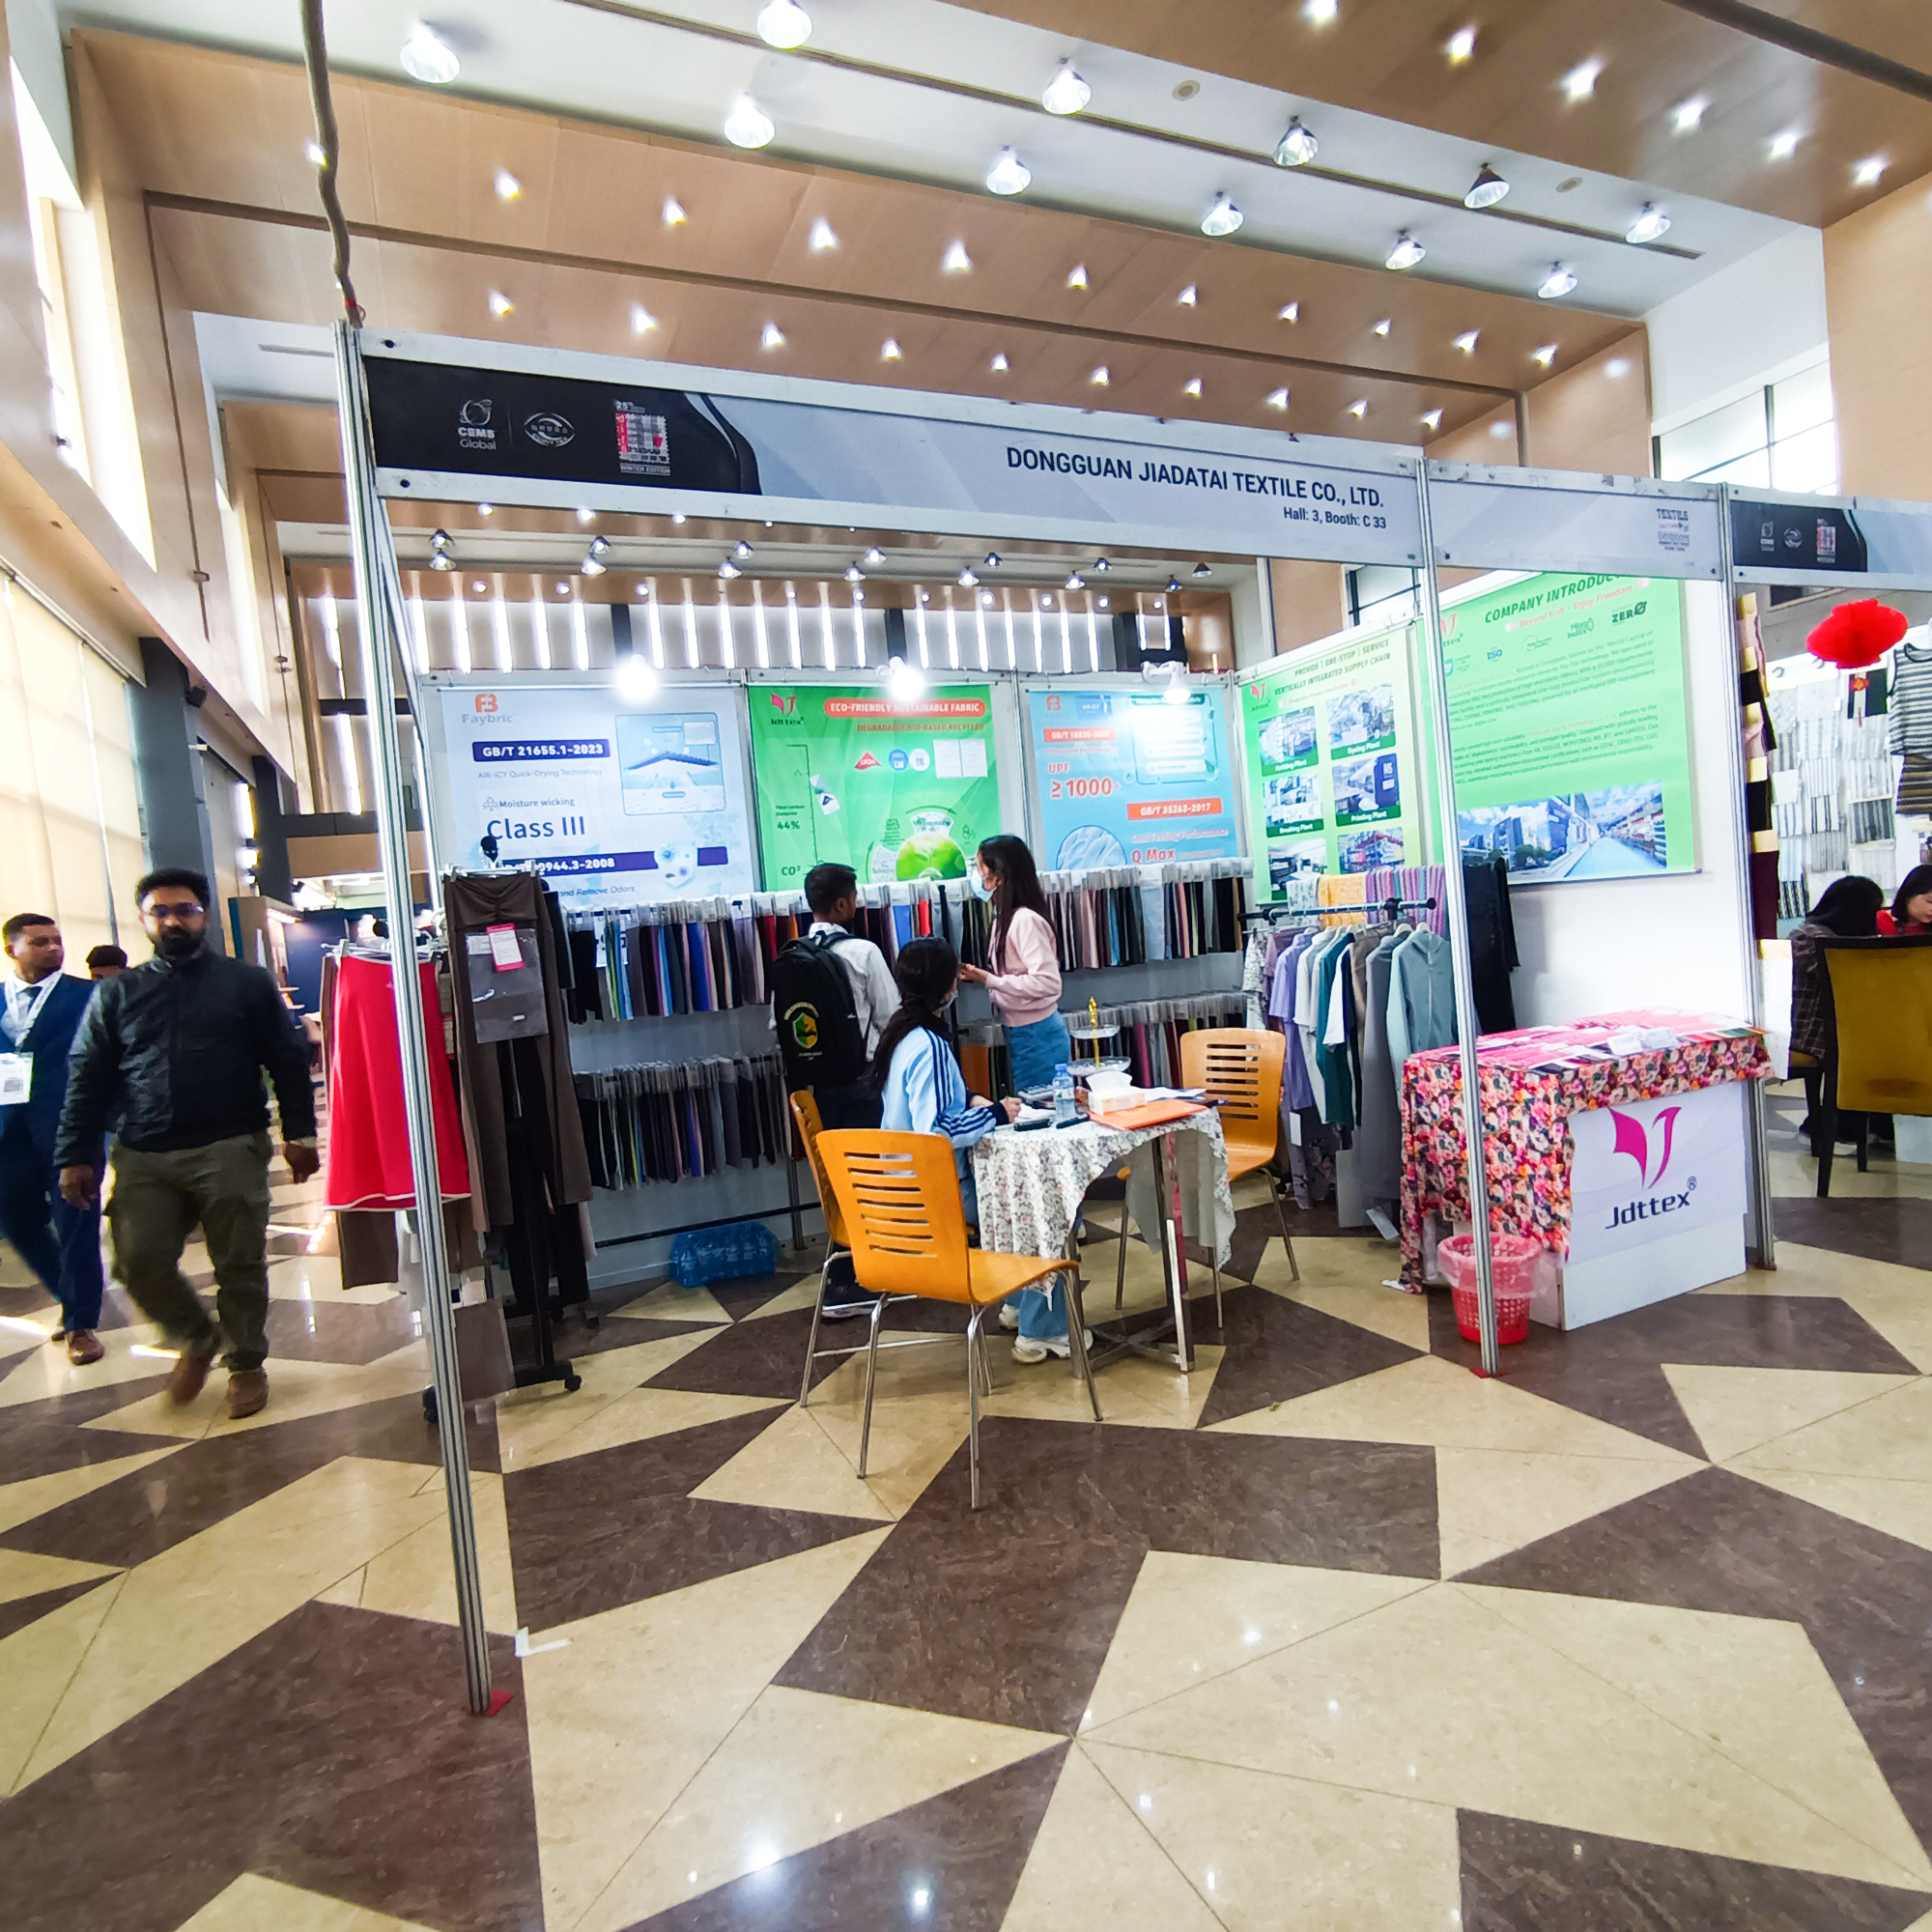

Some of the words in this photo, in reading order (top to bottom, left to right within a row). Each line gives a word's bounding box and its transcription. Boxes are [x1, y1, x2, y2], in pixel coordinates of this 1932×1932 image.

[458, 427, 495, 439] CEMS
[460, 439, 497, 449] Global
[1007, 447, 1132, 480] DONGGUAN
[1139, 462, 1228, 491] JIADATAI
[1233, 472, 1308, 498] TEXTILE
[1312, 482, 1346, 506] CO.,
[1350, 486, 1384, 508] LTD.
[1283, 506, 1309, 521] Hall:
[1312, 509, 1323, 525] 3,
[1324, 511, 1360, 526] Booth:
[1363, 515, 1371, 527] C
[1373, 516, 1387, 529] 33
[1485, 593, 1544, 623] COMPANY
[1547, 574, 1619, 603] INTRODUC
[1597, 585, 1633, 602] Freedom
[1363, 639, 1389, 654] SERVICE
[1487, 649, 1502, 660] ISO
[1308, 668, 1343, 685] INTEGRATED
[1345, 660, 1369, 673] SUPPLY
[1370, 653, 1391, 666] CHAIN
[831, 703, 891, 713] ECO-FRIENDLY
[951, 702, 980, 712] FABRIC
[462, 713, 514, 725] Faybric
[483, 746, 514, 757] GB/T
[518, 743, 604, 756] 21655.1-2023
[1049, 763, 1069, 774] UPF
[499, 798, 539, 808] Moisture
[540, 797, 576, 808] wicking
[1140, 806, 1161, 815] GB/T
[487, 818, 554, 839] Class
[777, 820, 801, 830] 44%
[1132, 850, 1142, 864] Q
[1147, 849, 1175, 861] Max
[576, 888, 609, 896] Remove
